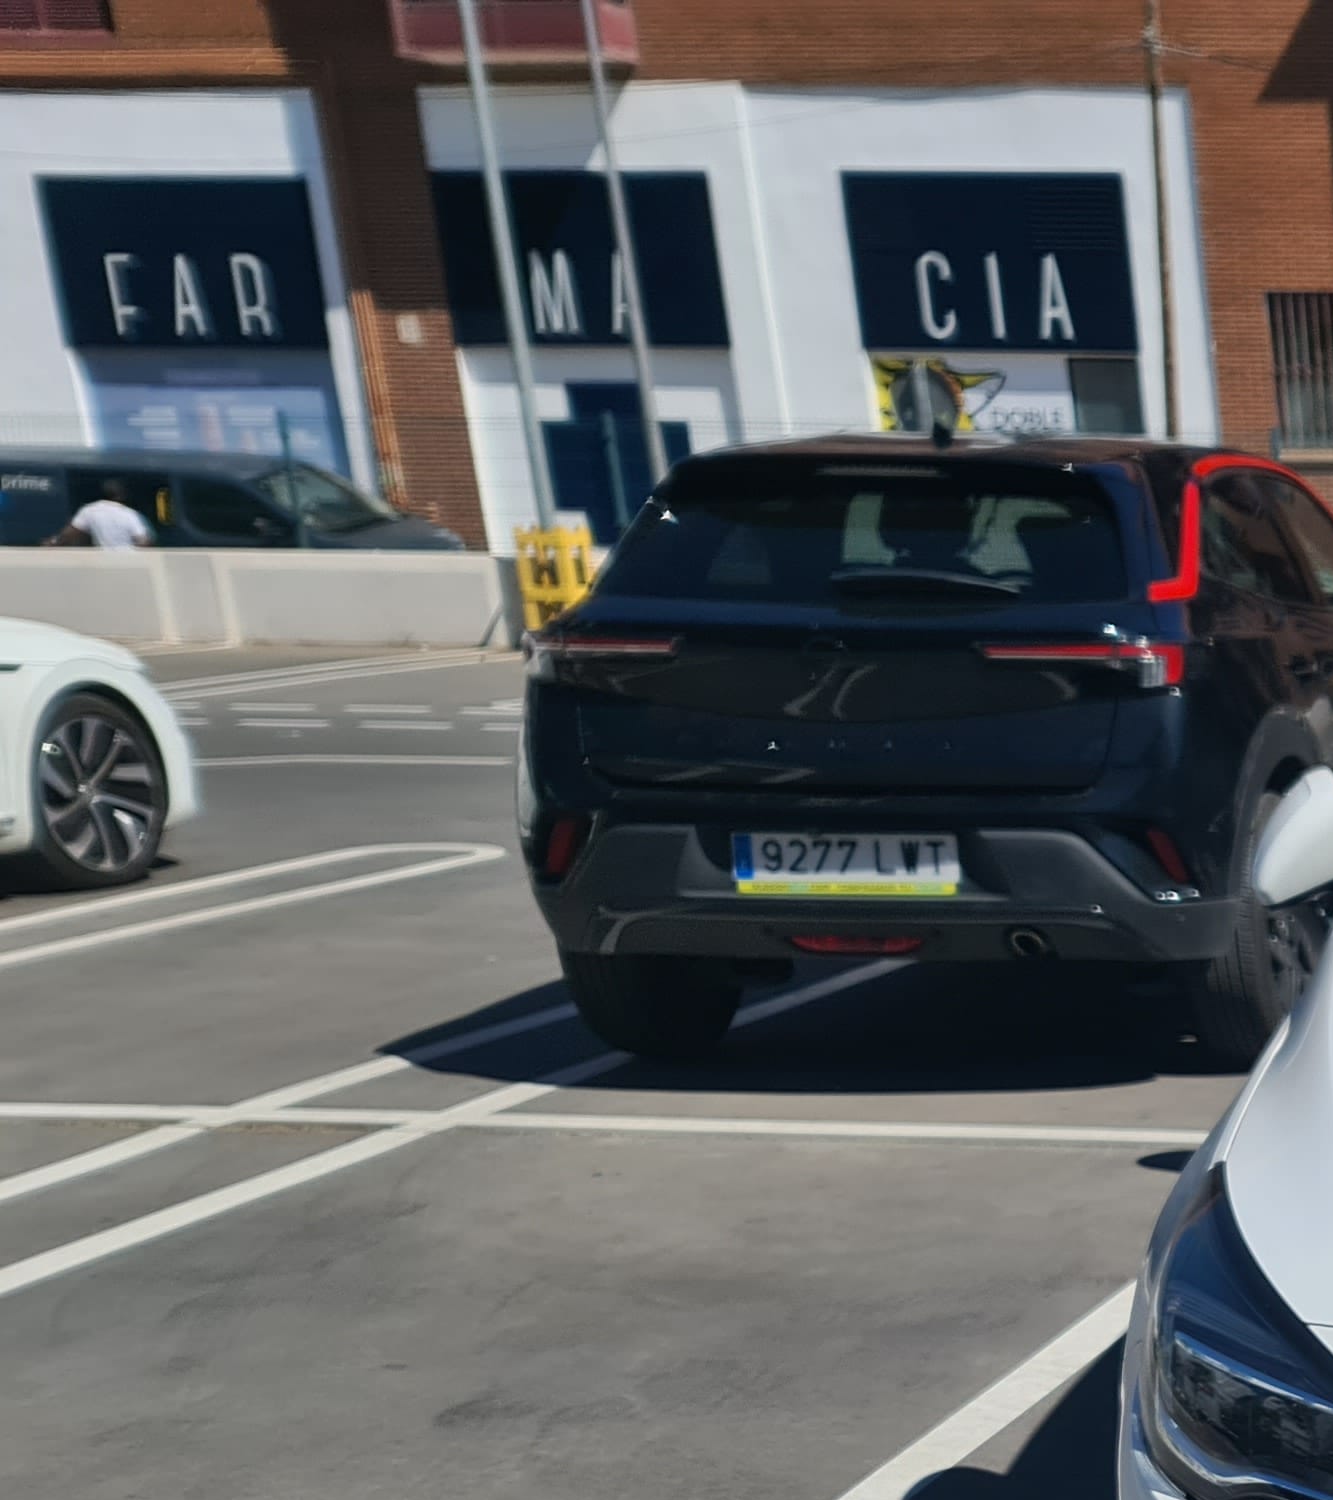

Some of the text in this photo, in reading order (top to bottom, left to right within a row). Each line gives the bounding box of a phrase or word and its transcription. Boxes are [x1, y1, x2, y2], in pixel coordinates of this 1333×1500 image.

[104, 252, 275, 337] FAR
[915, 250, 1076, 340] CIA
[761, 839, 946, 876] 9277 LWT
